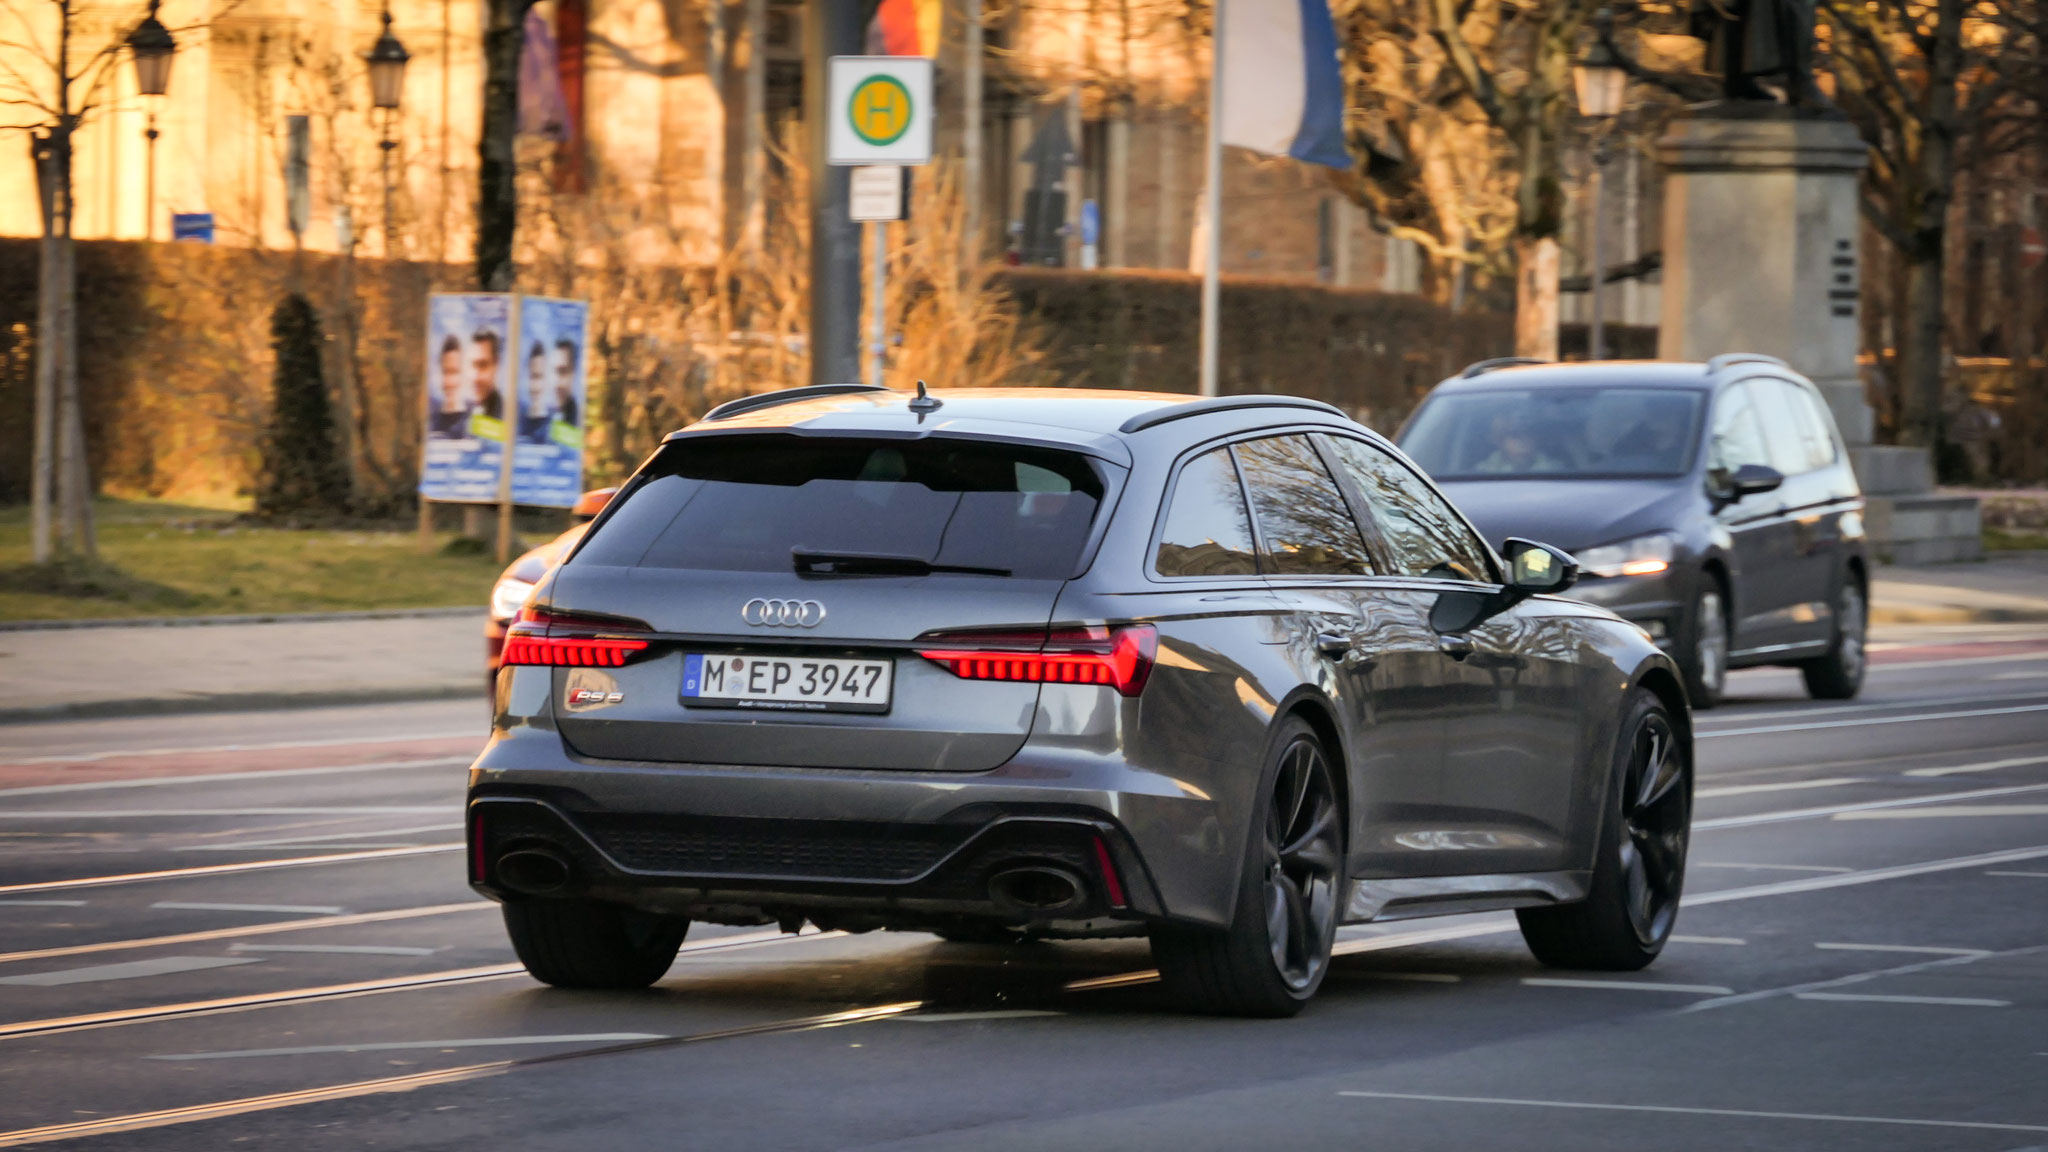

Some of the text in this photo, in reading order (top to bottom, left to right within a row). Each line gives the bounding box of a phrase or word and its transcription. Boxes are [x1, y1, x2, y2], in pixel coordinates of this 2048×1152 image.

[866, 91, 896, 130] H
[704, 660, 882, 697] M EP 3947
